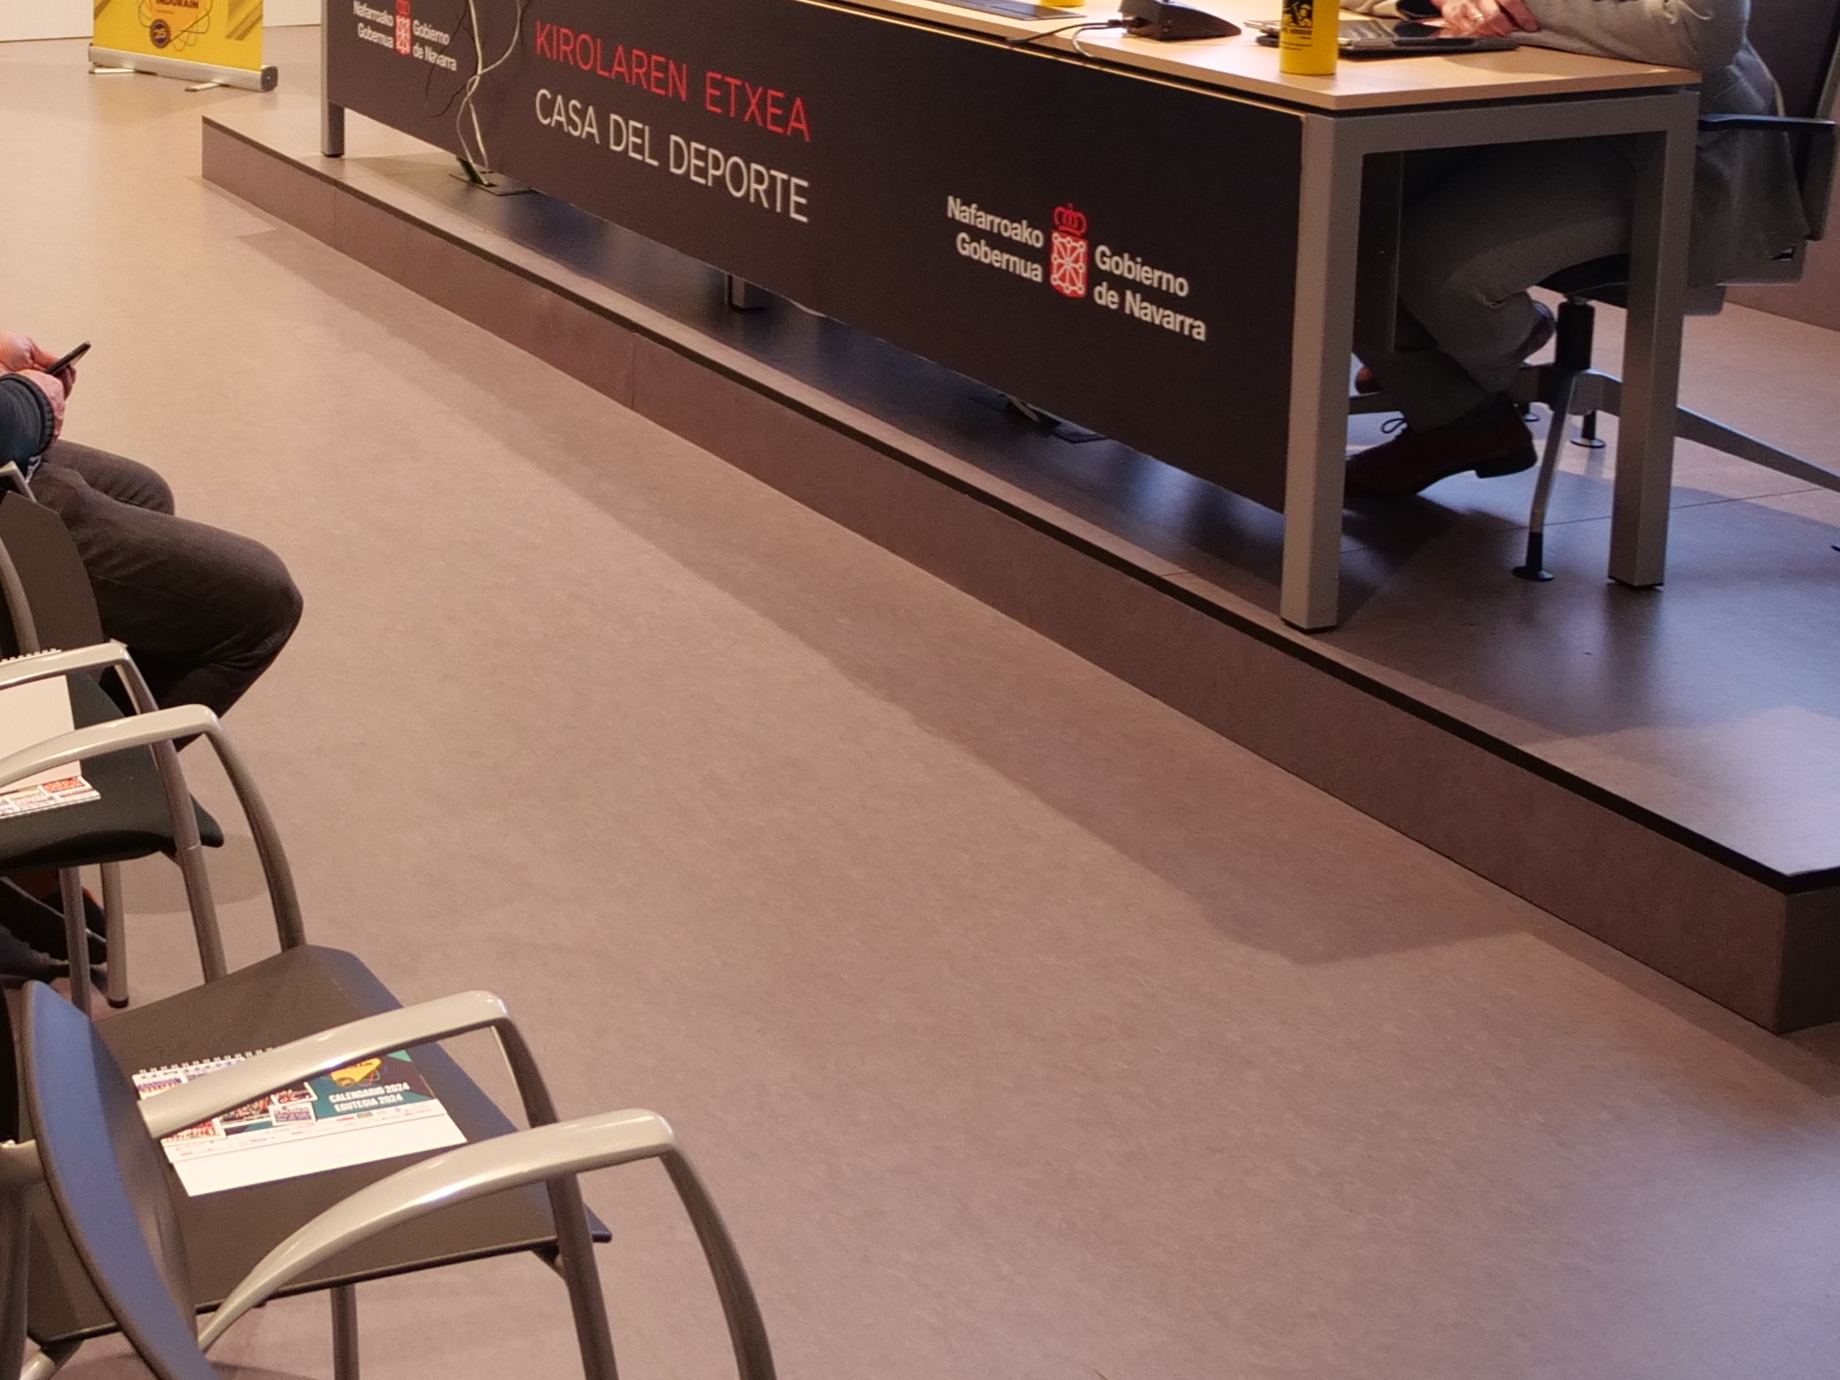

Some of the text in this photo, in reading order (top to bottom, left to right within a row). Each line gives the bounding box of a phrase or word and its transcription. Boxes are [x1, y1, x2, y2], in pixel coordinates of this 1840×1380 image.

[353, 0, 395, 28] Nafarroako
[357, 21, 395, 49] Gobernua
[412, 19, 451, 46] Gobierno
[412, 41, 458, 72] de Navarra
[534, 19, 811, 142] KIROLAREN ETXEA
[535, 88, 810, 223] CASA DEL DEPORTE
[947, 194, 1044, 249] Nafarroako
[956, 231, 1044, 284] Gobernua
[1094, 244, 1190, 298] Gobierno
[1093, 280, 1207, 343] de Navarra
[328, 1082, 410, 1103] CALENDARIO 2024
[334, 1093, 403, 1112] EGUTEGIA 2024
